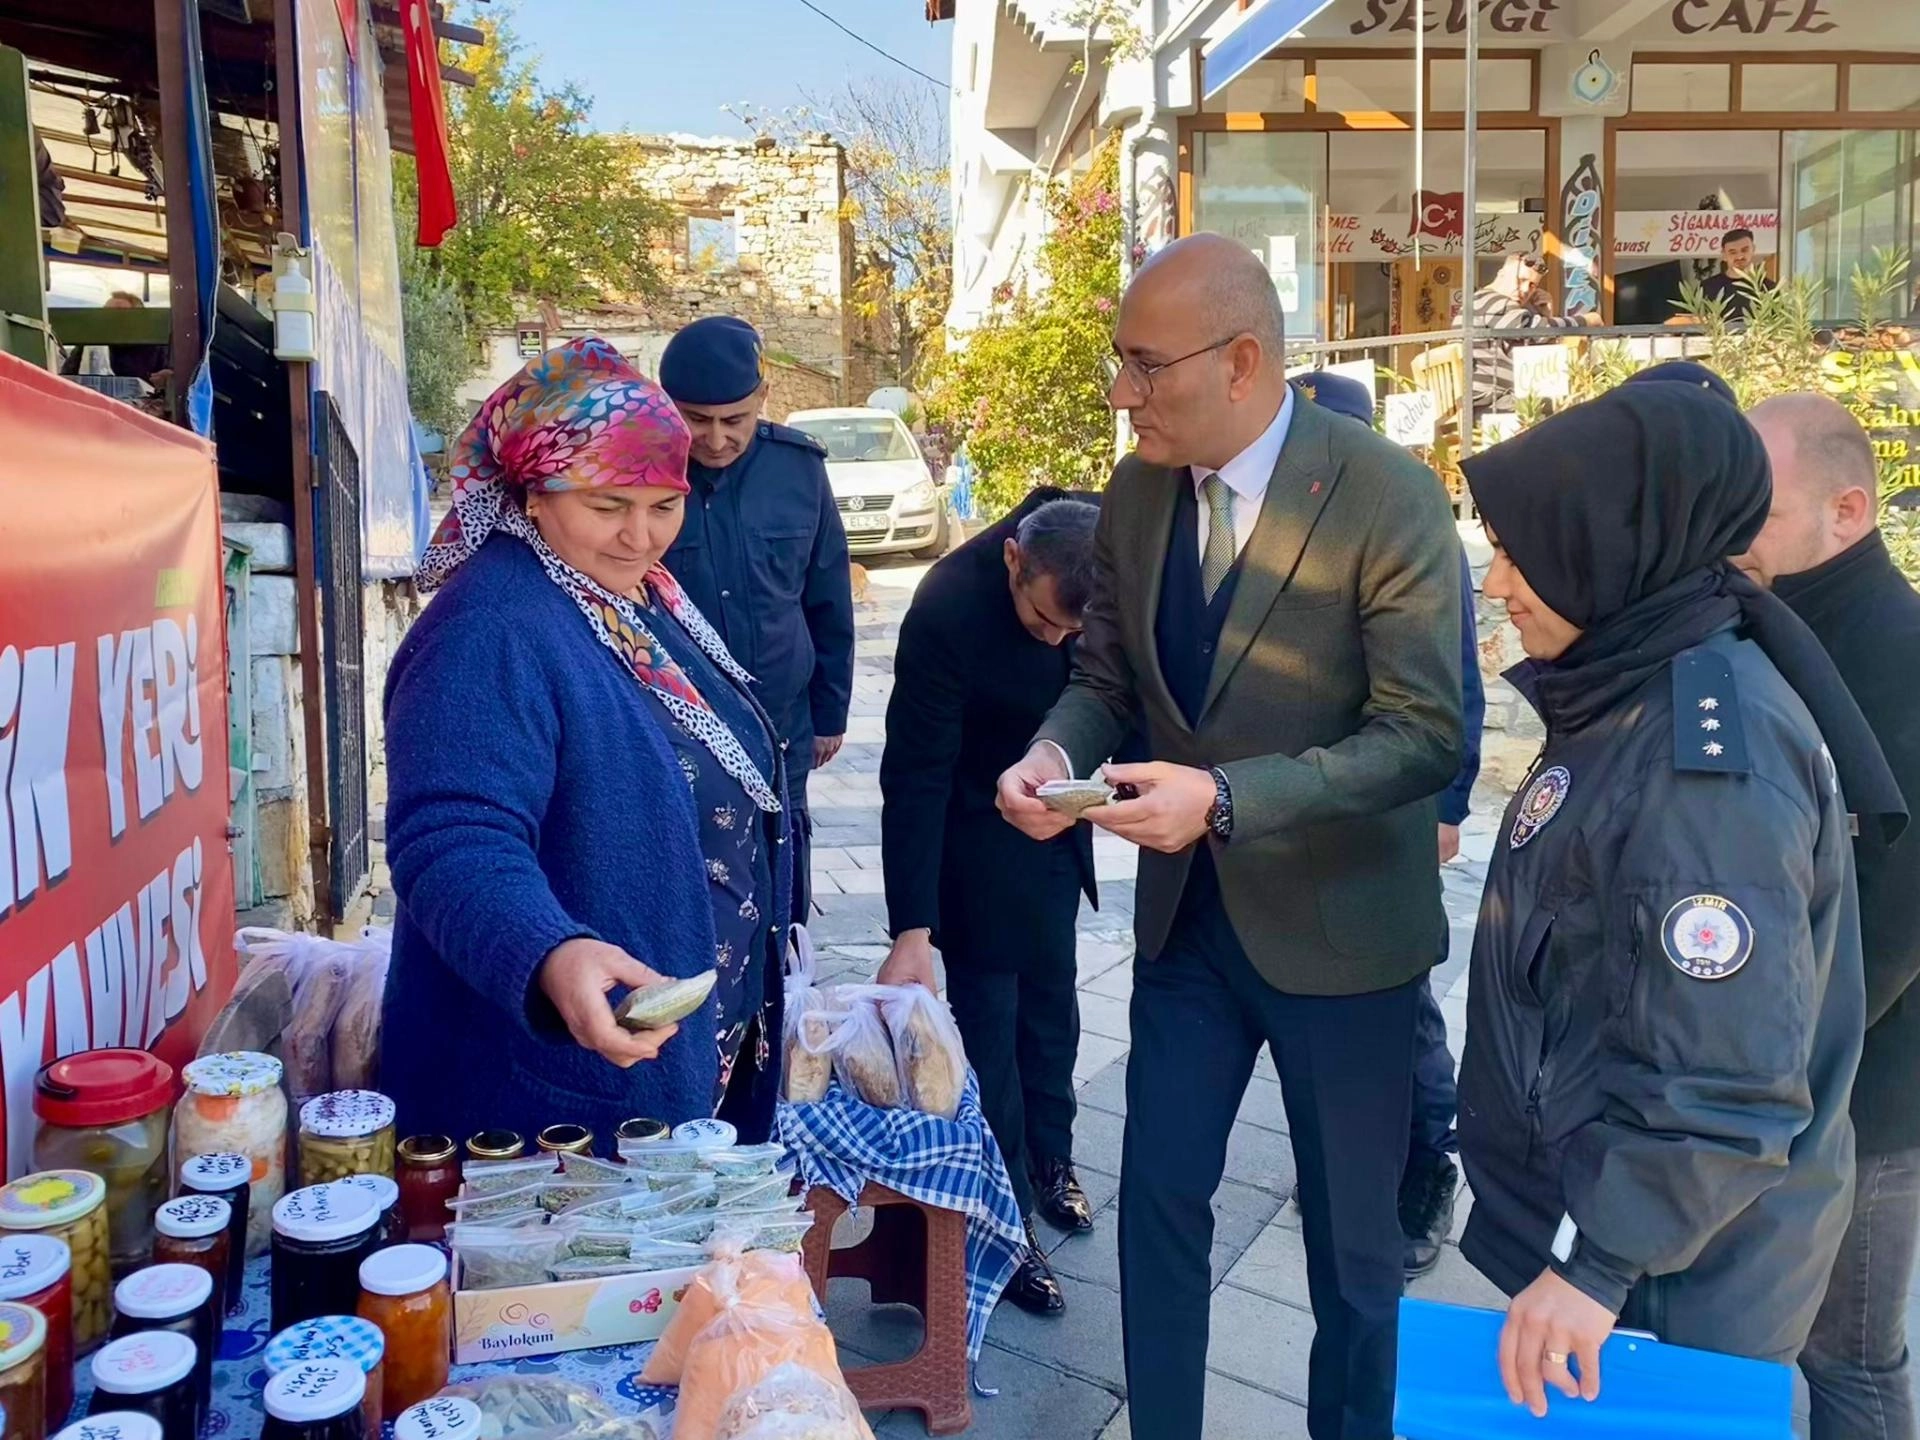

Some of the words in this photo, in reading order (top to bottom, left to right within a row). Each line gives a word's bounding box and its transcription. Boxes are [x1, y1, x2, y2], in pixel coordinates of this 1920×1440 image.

[1672, 0, 1839, 34] CAFE
[1669, 232, 1720, 252] Böre
[98, 613, 203, 838] YERİ
[480, 1333, 554, 1350] Baylokum
